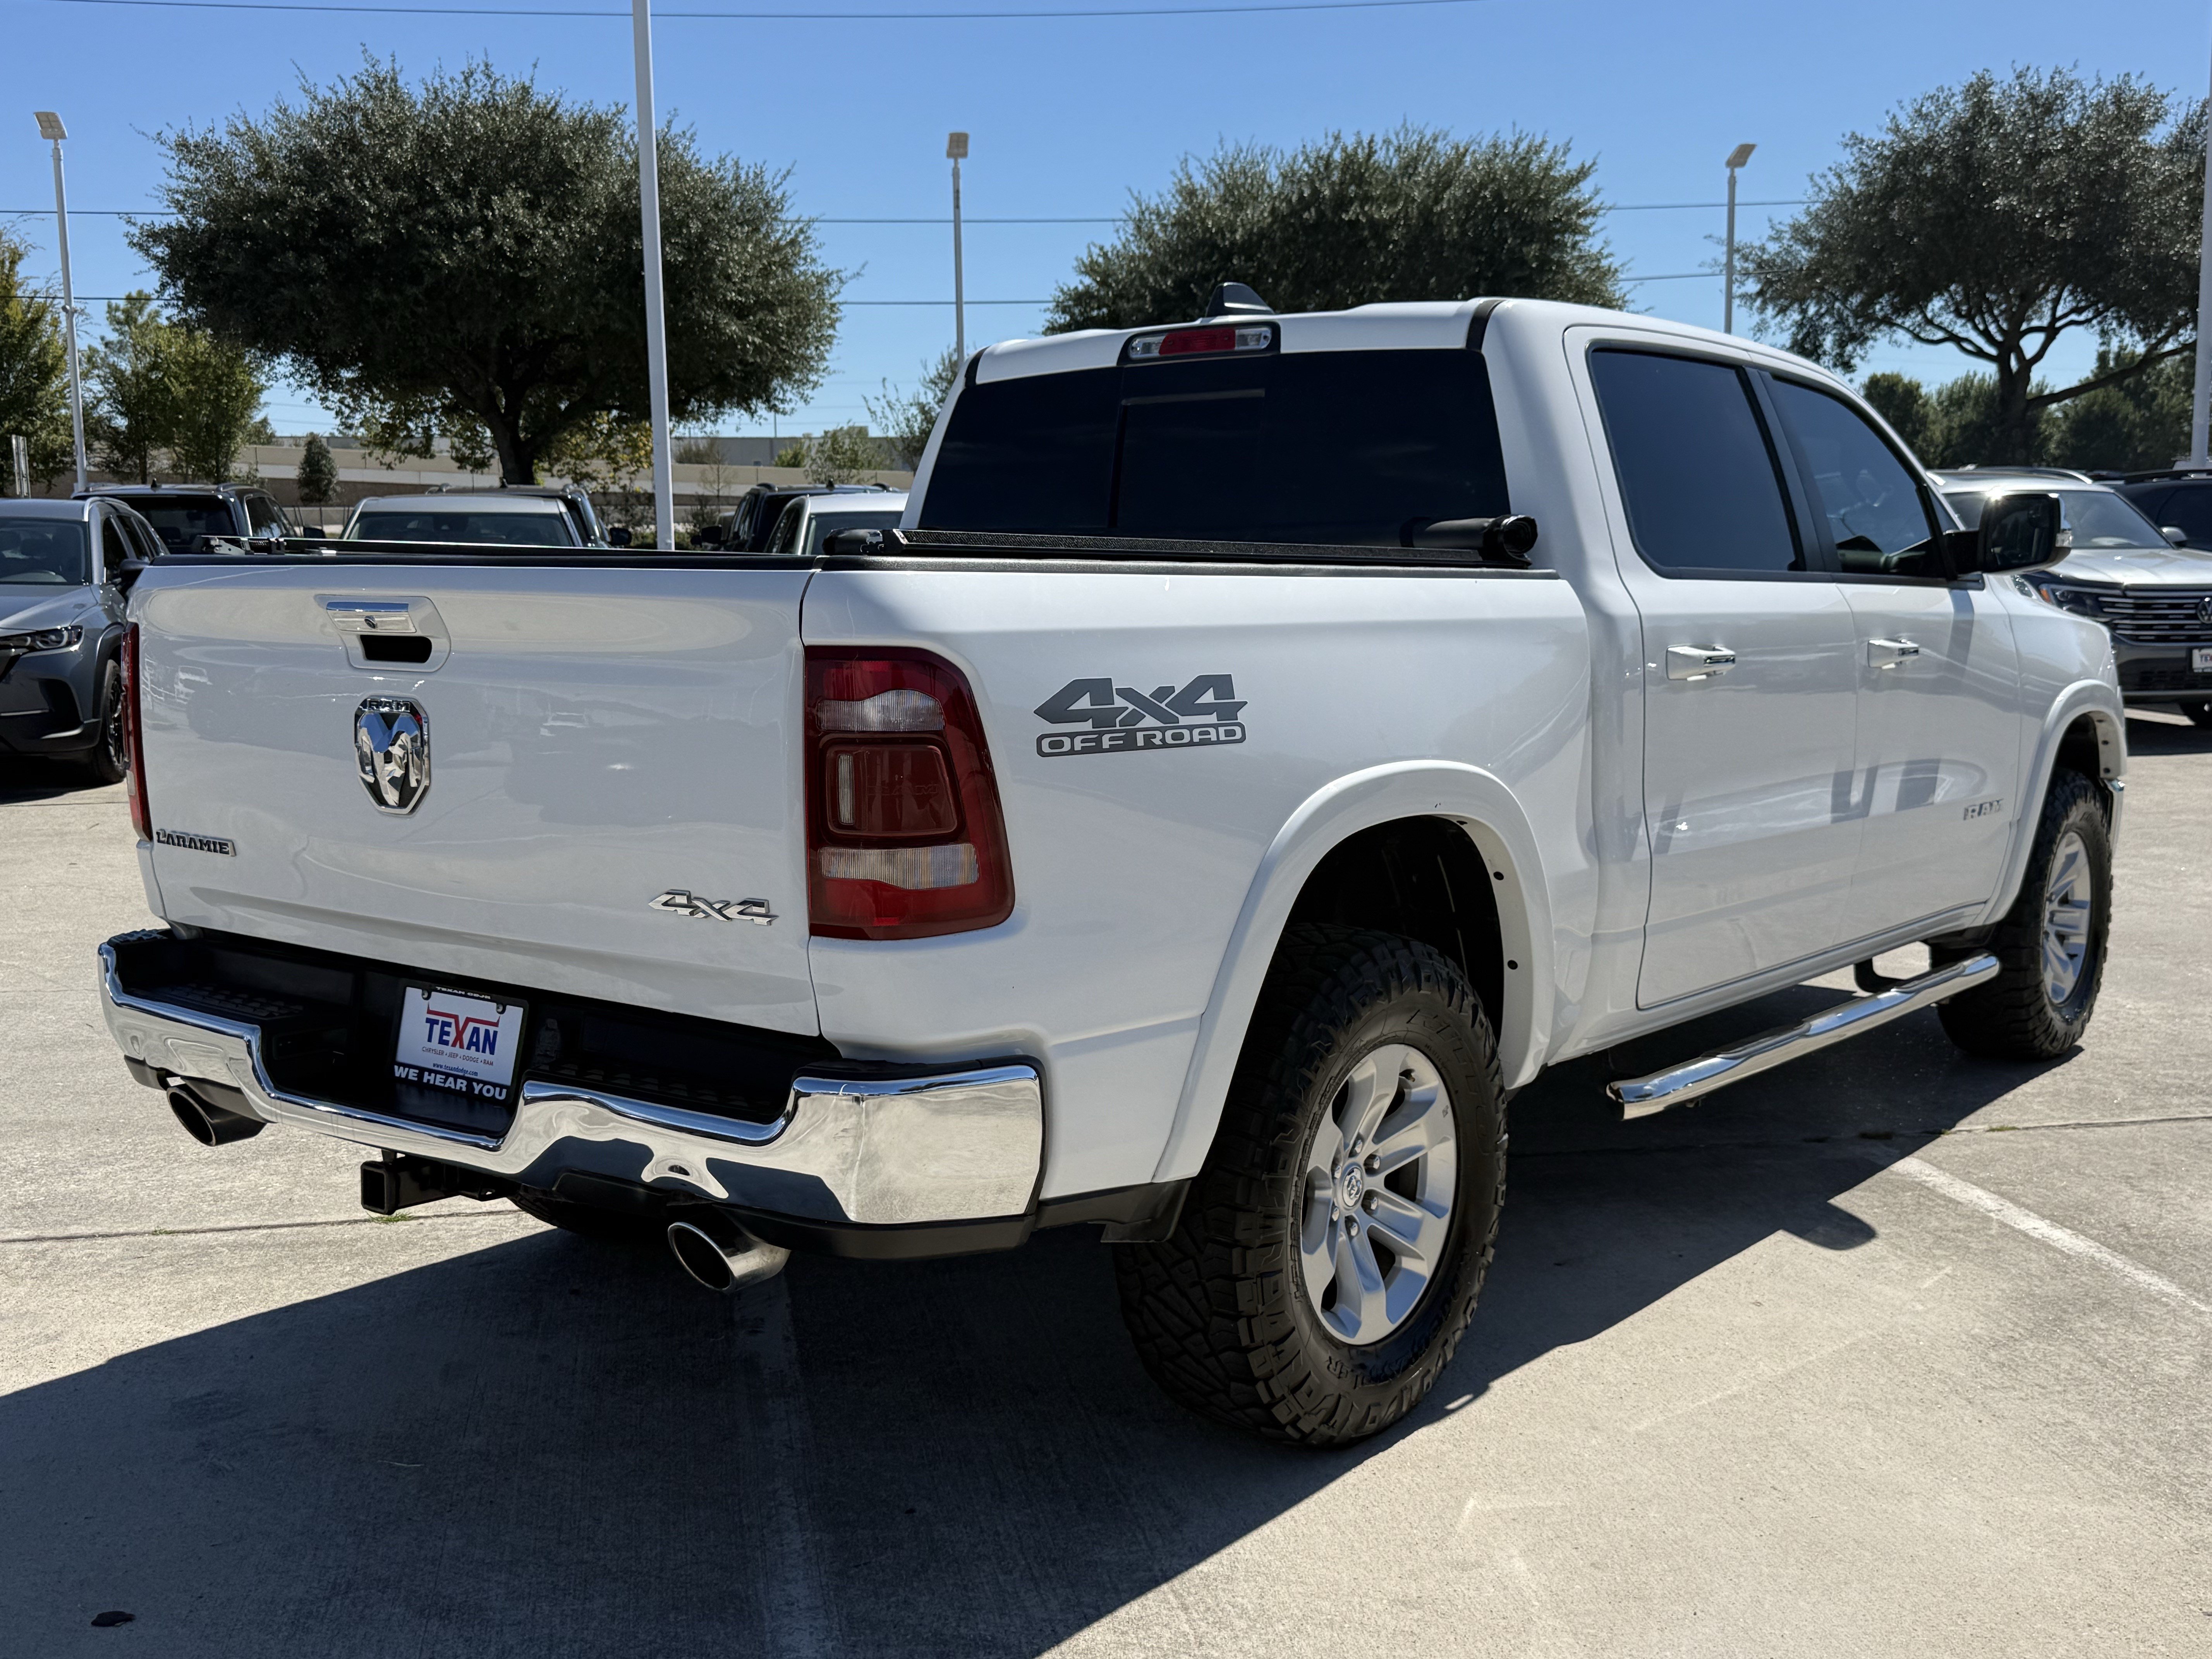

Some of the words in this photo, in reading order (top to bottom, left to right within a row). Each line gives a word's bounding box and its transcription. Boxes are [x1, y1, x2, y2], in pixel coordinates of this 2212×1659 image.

[367, 698, 410, 712] RAM
[1041, 733, 1127, 753] OFF
[1136, 726, 1242, 746] ROAD
[1963, 798, 2004, 820] RAM
[156, 830, 235, 856] LARAMIE
[425, 1014, 499, 1055] TEXAN
[422, 1046, 445, 1056] CHRYSLER
[462, 1054, 479, 1063] DODGE
[433, 1062, 478, 1076] www.texandodge.com
[394, 1065, 419, 1081] WE
[423, 1072, 467, 1092] HEAR
[472, 1082, 507, 1100] YOU
